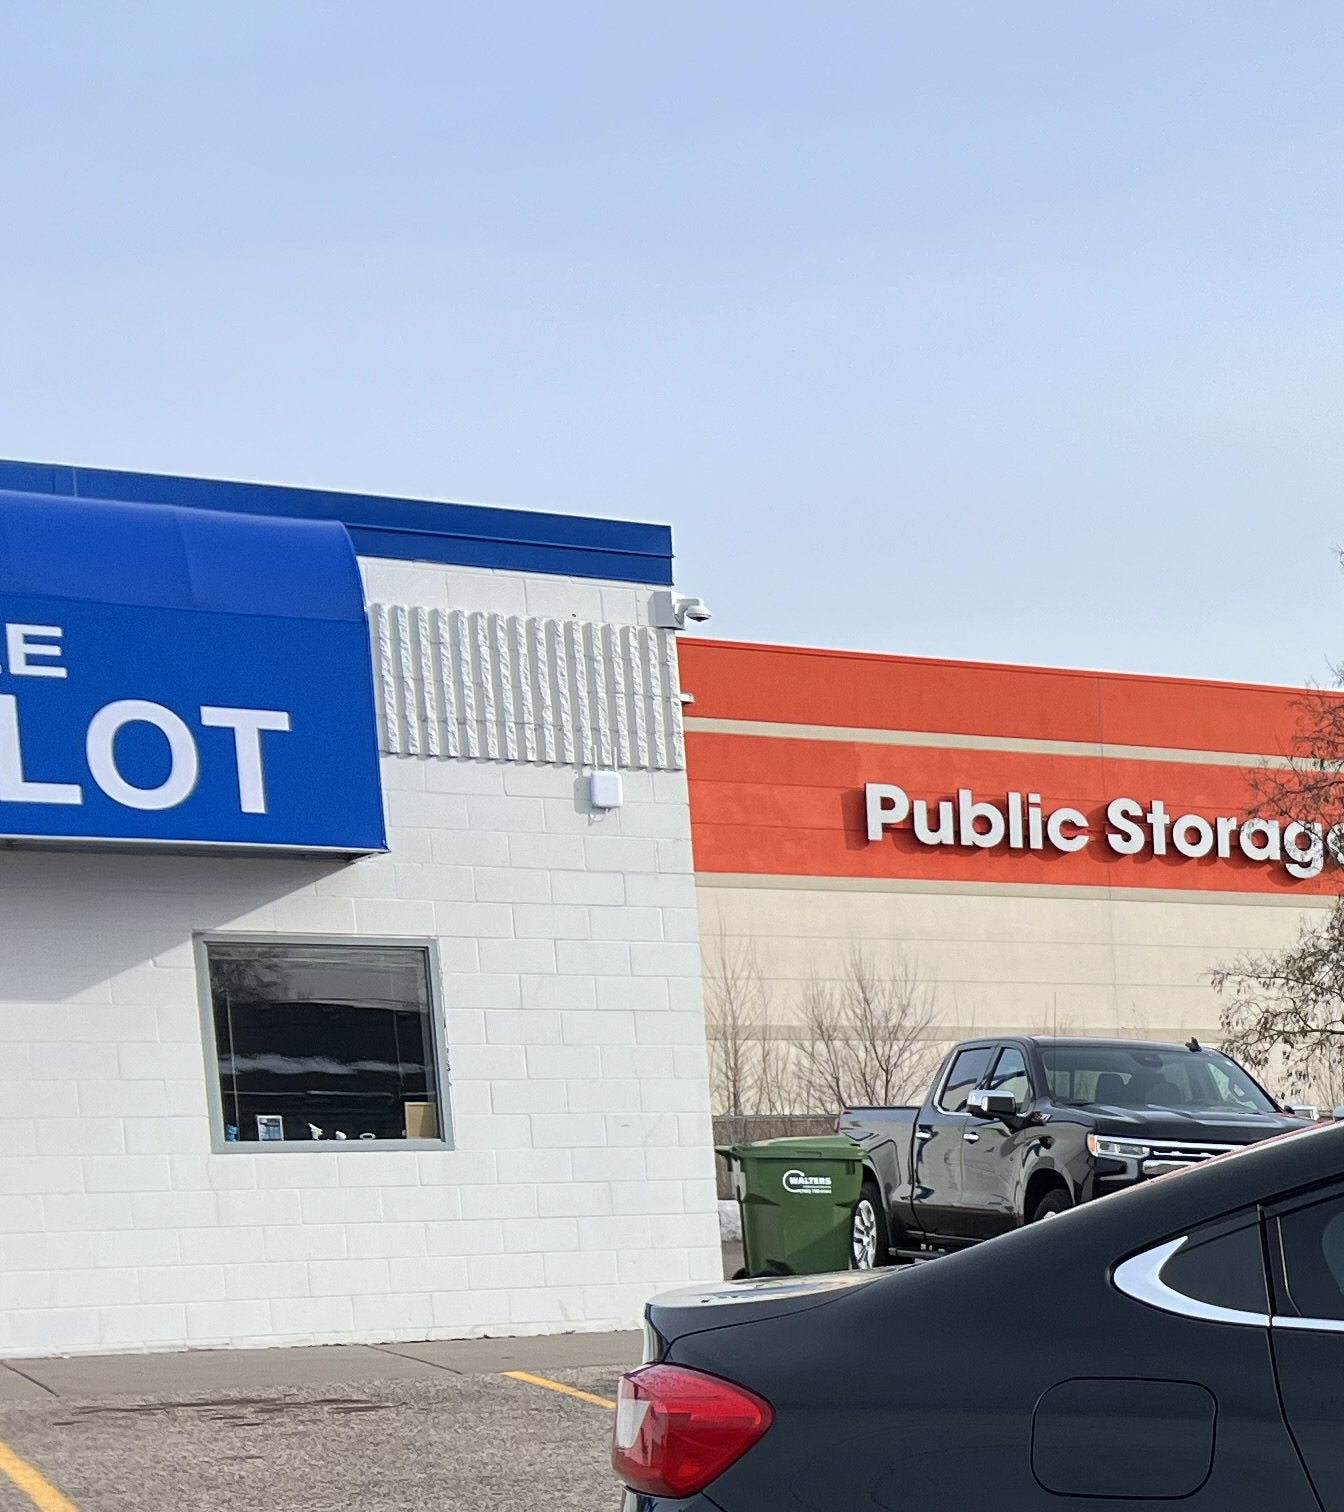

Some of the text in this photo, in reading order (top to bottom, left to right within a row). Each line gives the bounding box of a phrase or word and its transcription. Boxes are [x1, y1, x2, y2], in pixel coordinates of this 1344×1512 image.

[0, 623, 67, 678] E
[0, 693, 291, 814] LOT
[865, 783, 1089, 852] Public
[790, 1176, 832, 1185] WALTERS
